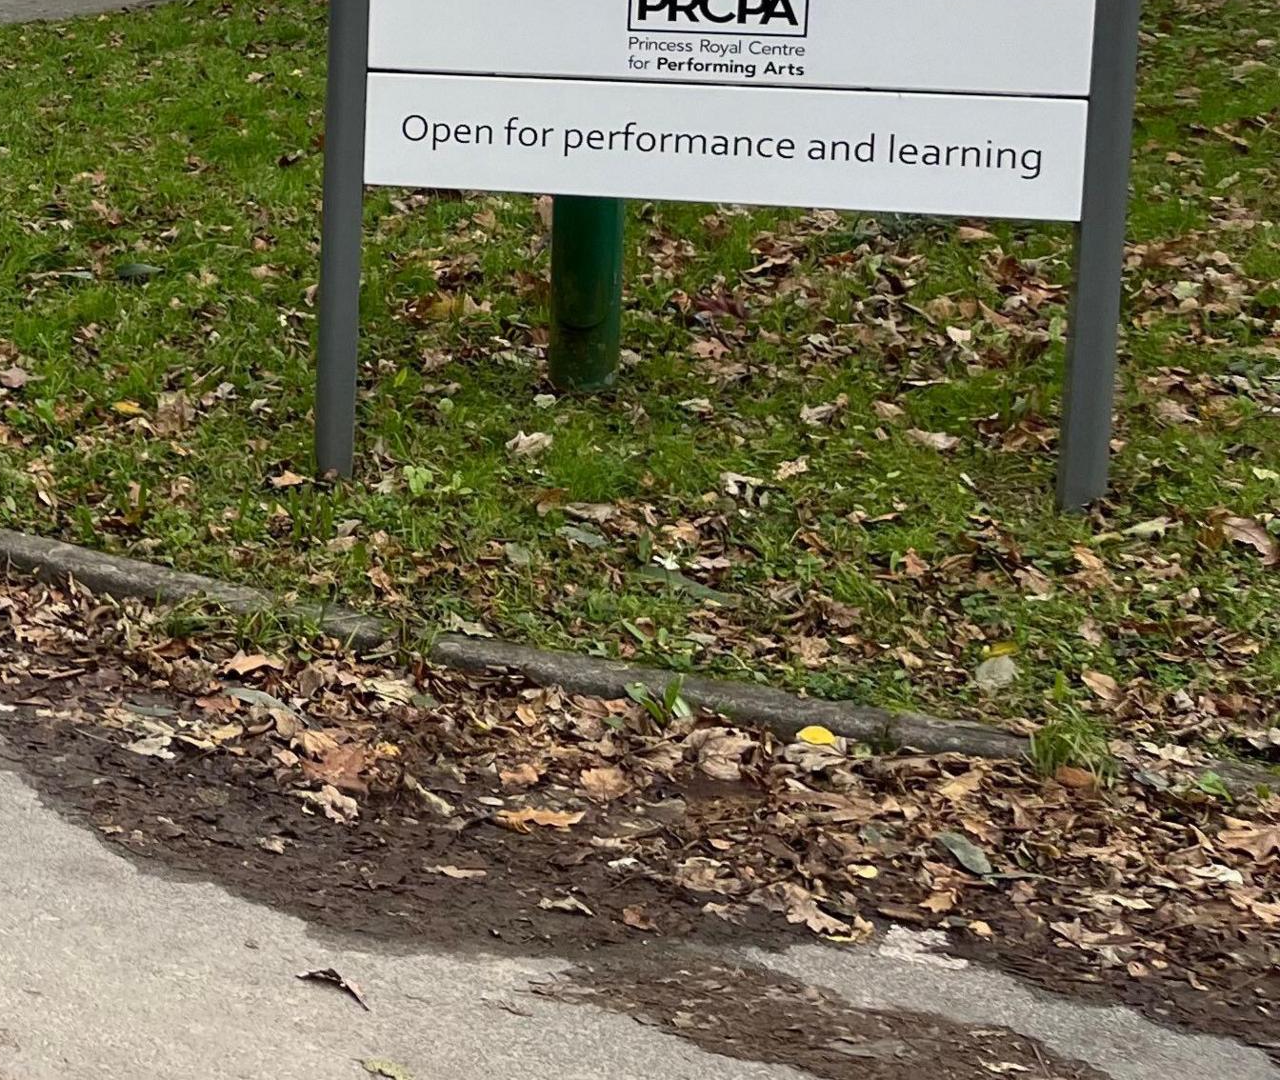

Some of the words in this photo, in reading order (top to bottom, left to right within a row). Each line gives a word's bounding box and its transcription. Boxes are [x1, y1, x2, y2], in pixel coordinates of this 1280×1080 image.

[628, 36, 693, 52] Princess
[700, 39, 742, 57] Royal
[748, 41, 806, 57] Centre
[628, 55, 650, 70] for
[657, 57, 756, 78] Performing
[763, 62, 805, 76] Arts
[401, 113, 494, 151] Open
[503, 116, 554, 148] for
[563, 120, 796, 160] performance
[808, 131, 876, 164] and
[889, 134, 1044, 180] learning
